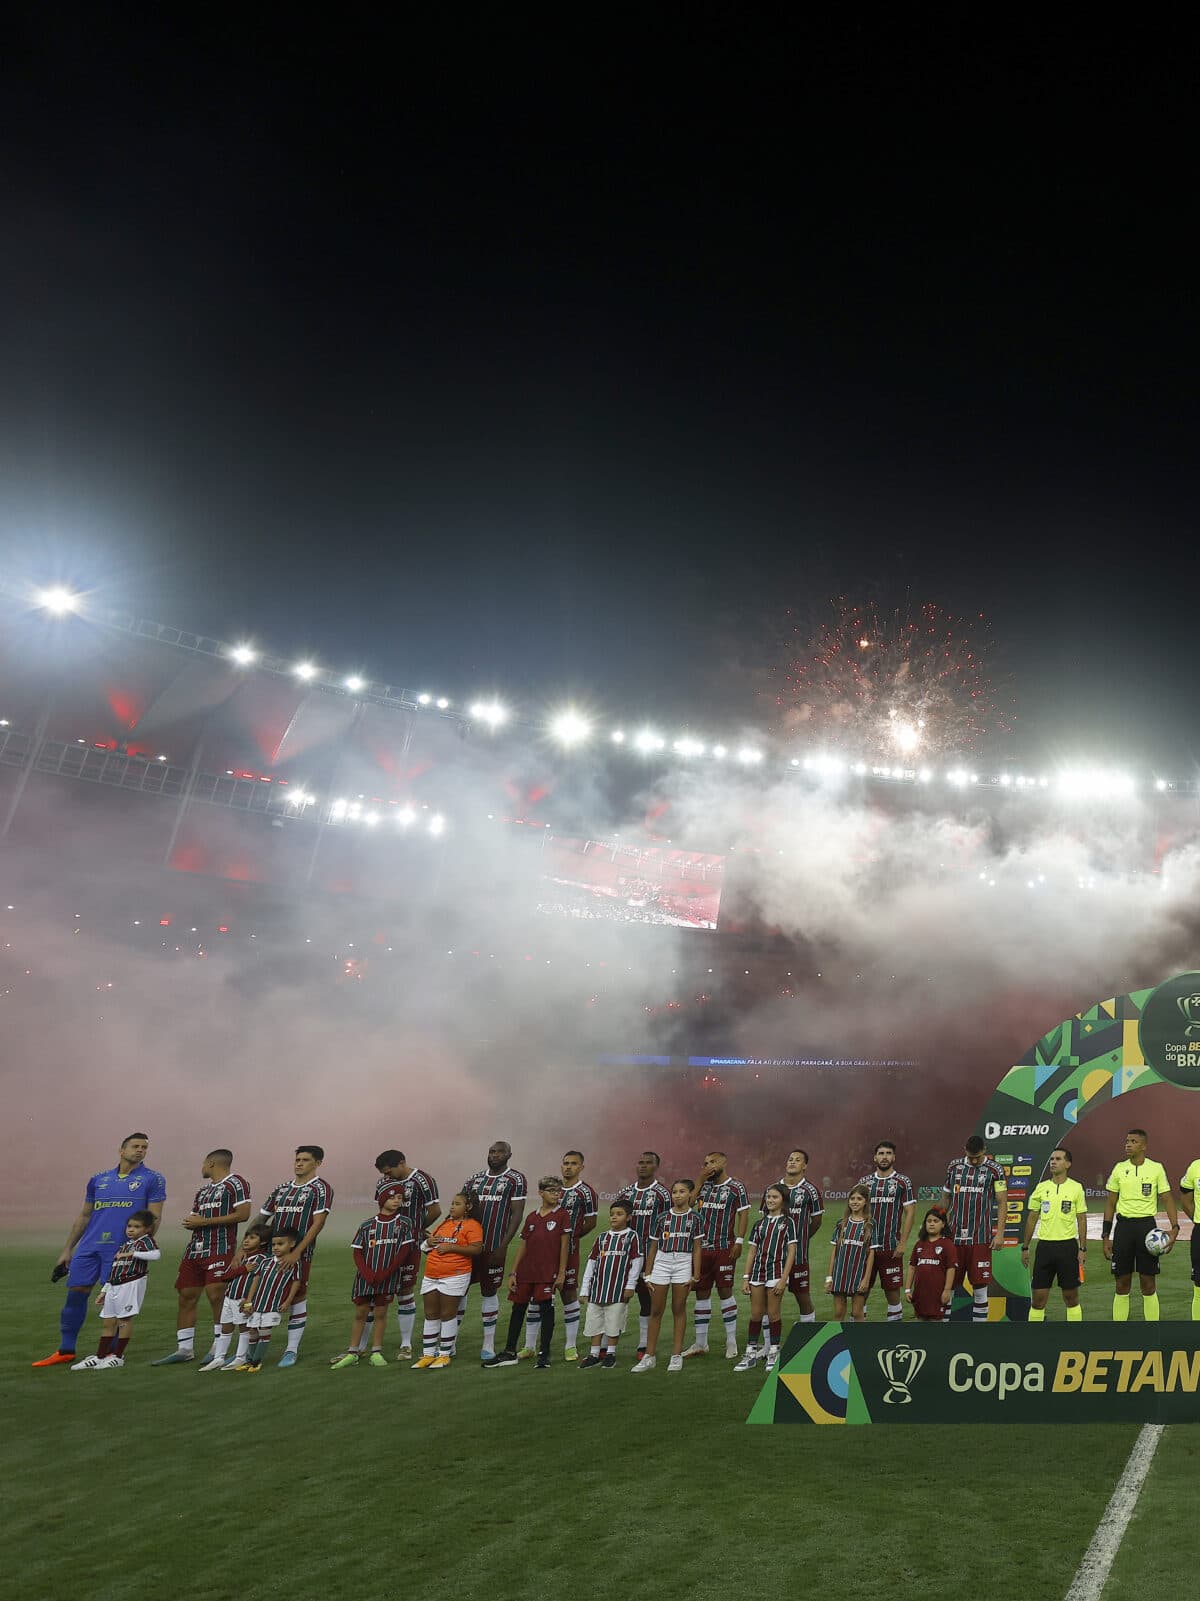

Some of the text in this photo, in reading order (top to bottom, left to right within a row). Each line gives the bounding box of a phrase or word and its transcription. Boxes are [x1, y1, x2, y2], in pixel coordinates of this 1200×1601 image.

[1165, 1043, 1187, 1052] Copa
[1165, 1053, 1177, 1061] do
[1002, 1124, 1050, 1136] BETANO
[948, 1352, 1045, 1401] Copa
